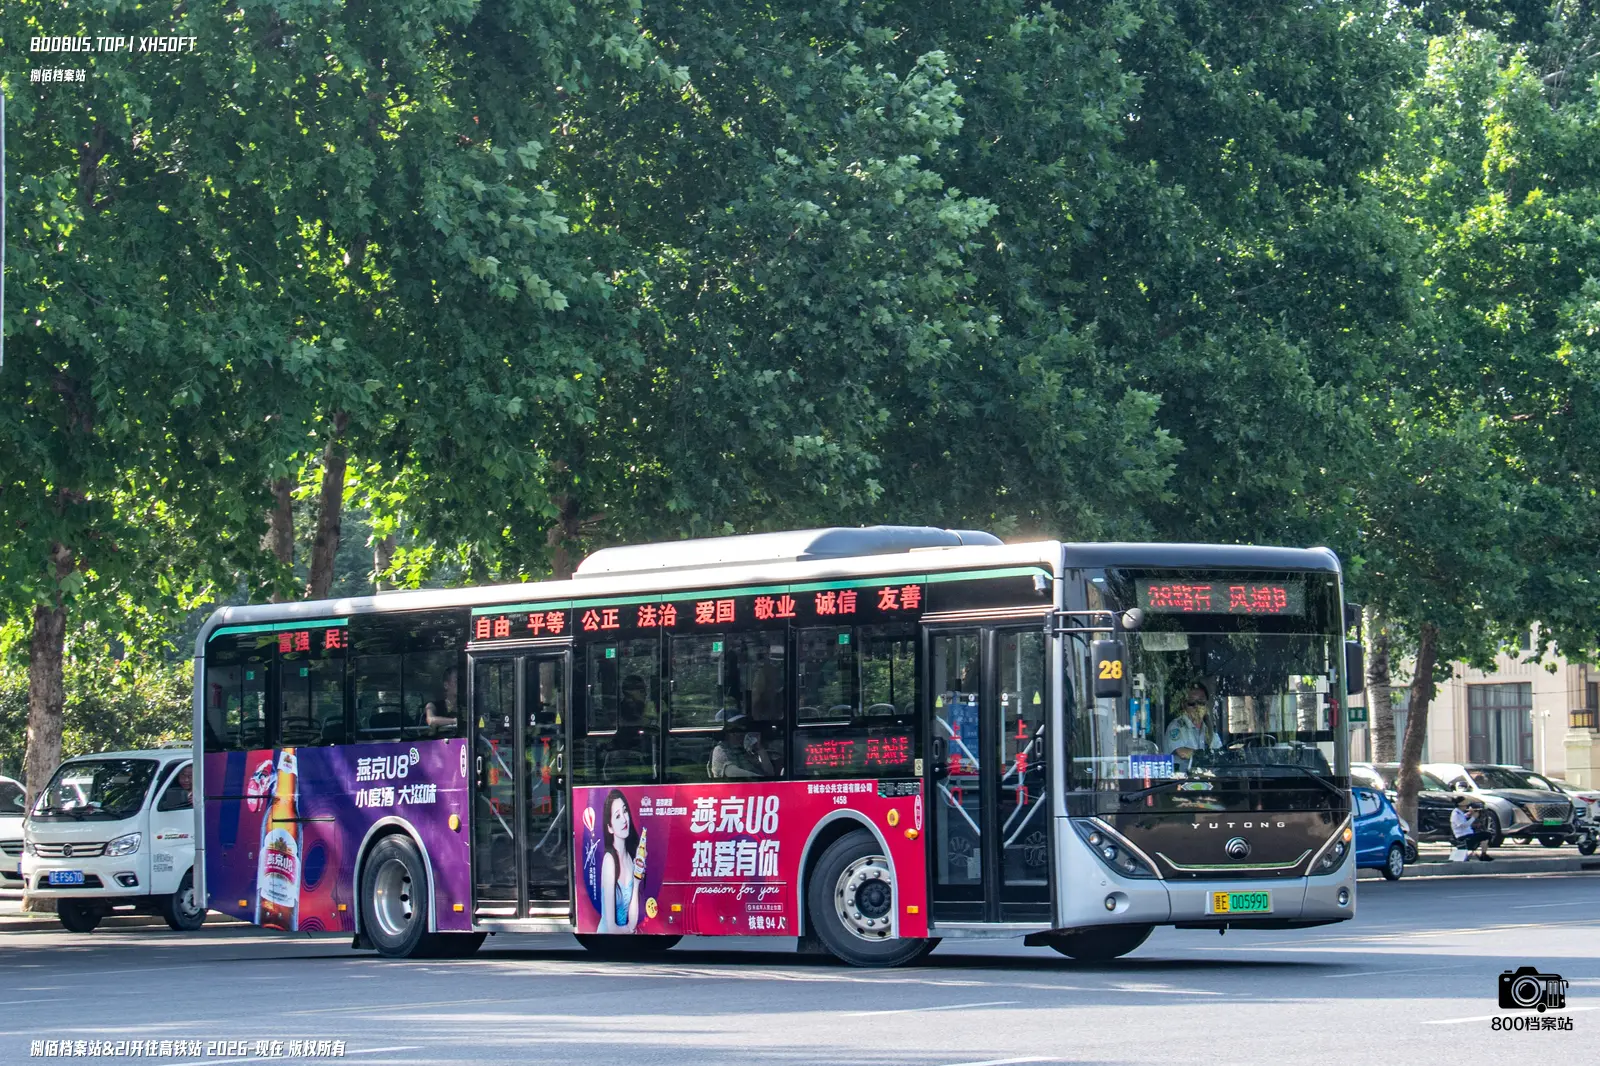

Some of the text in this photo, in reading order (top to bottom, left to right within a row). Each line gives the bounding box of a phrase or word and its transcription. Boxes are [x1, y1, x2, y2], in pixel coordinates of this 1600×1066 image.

[278, 631, 310, 653] 富强
[475, 615, 511, 639] 自由
[527, 611, 565, 635] 平等
[581, 609, 620, 631] 公正
[637, 604, 678, 628] 法治
[695, 599, 735, 625] 爱国
[754, 595, 796, 620] 敬业
[815, 590, 857, 615] 诚信
[878, 585, 922, 611] 友善
[1098, 660, 1123, 680] 28
[356, 755, 409, 782] 燕京U8
[355, 783, 437, 808] 小度酒 大滋味
[807, 783, 873, 794] 晋城市公共交通有限公司
[832, 795, 848, 805] 1458
[690, 795, 780, 834] 燕京U8
[1191, 821, 1286, 830] YUTONG
[691, 839, 779, 877] 热爱有你
[692, 882, 779, 904] passion for you
